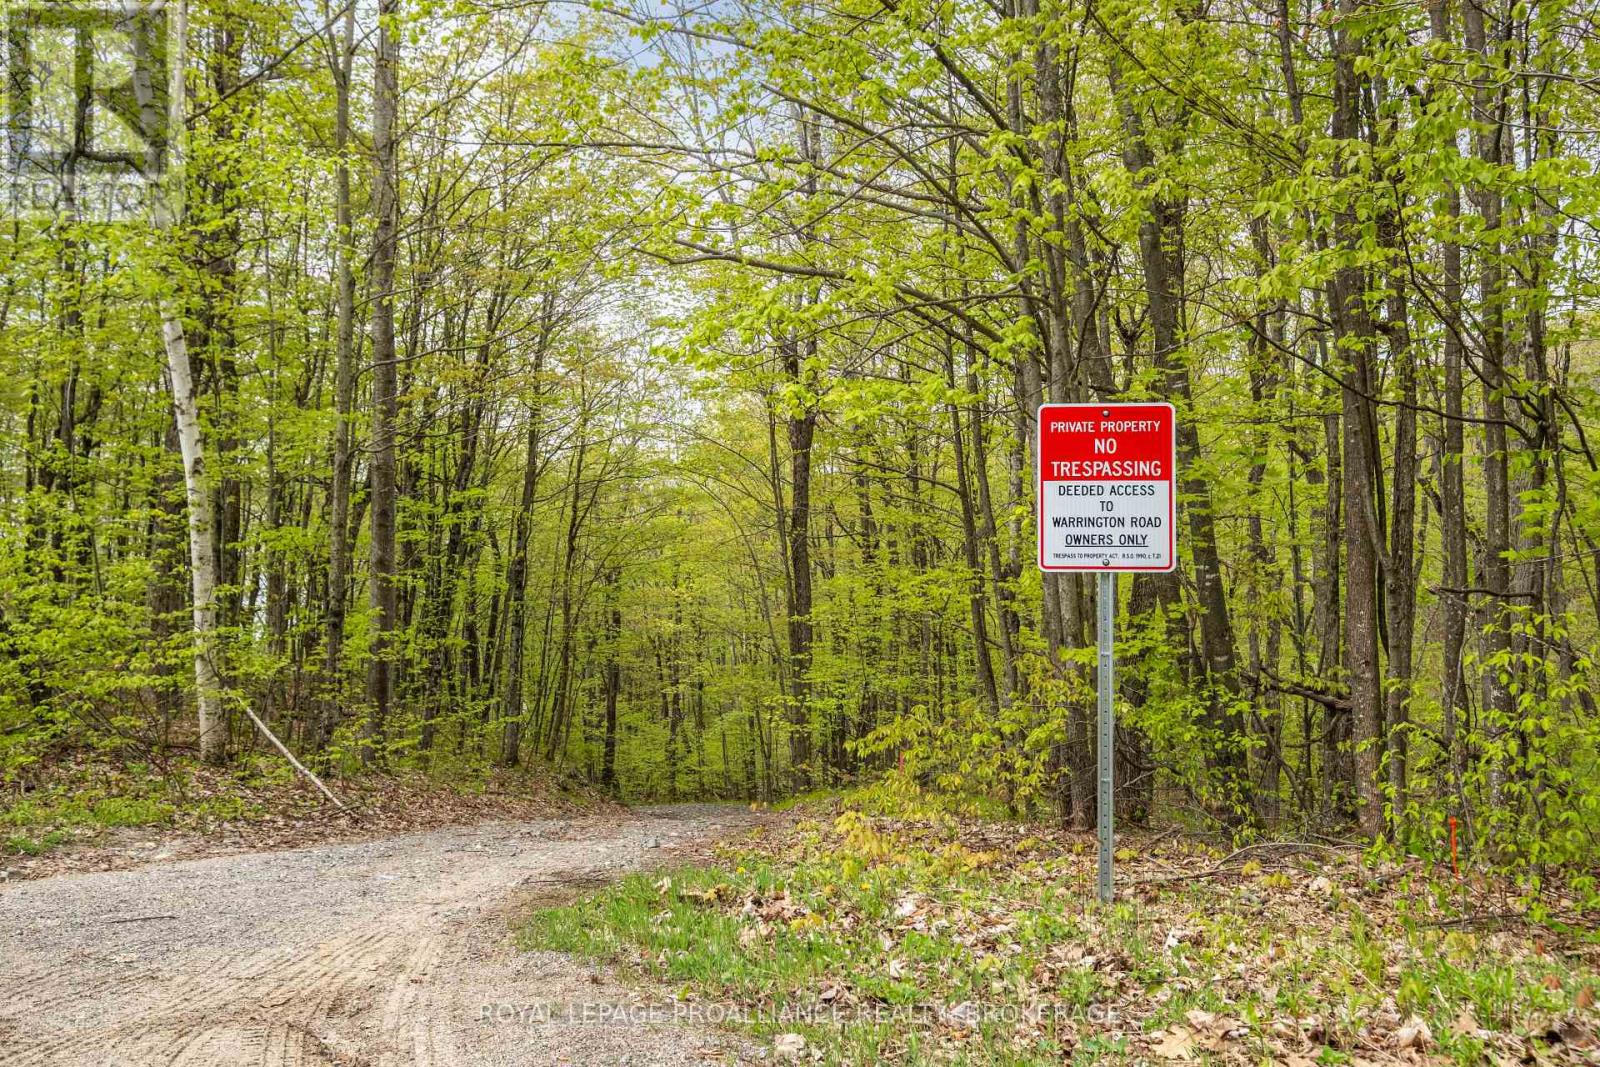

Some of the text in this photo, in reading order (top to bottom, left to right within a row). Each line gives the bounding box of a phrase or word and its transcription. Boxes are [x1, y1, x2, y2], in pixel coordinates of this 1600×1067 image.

[1051, 421, 1160, 433] PRIVATE PROPERTY
[1095, 439, 1117, 454] NO
[1051, 461, 1161, 477] TRESPASSING
[1058, 485, 1155, 496] DEEDED ACCESS
[1100, 501, 1113, 511] TO
[1053, 517, 1161, 528] WARRINGTON ROAD
[1065, 534, 1148, 545] OWNERS ONLY
